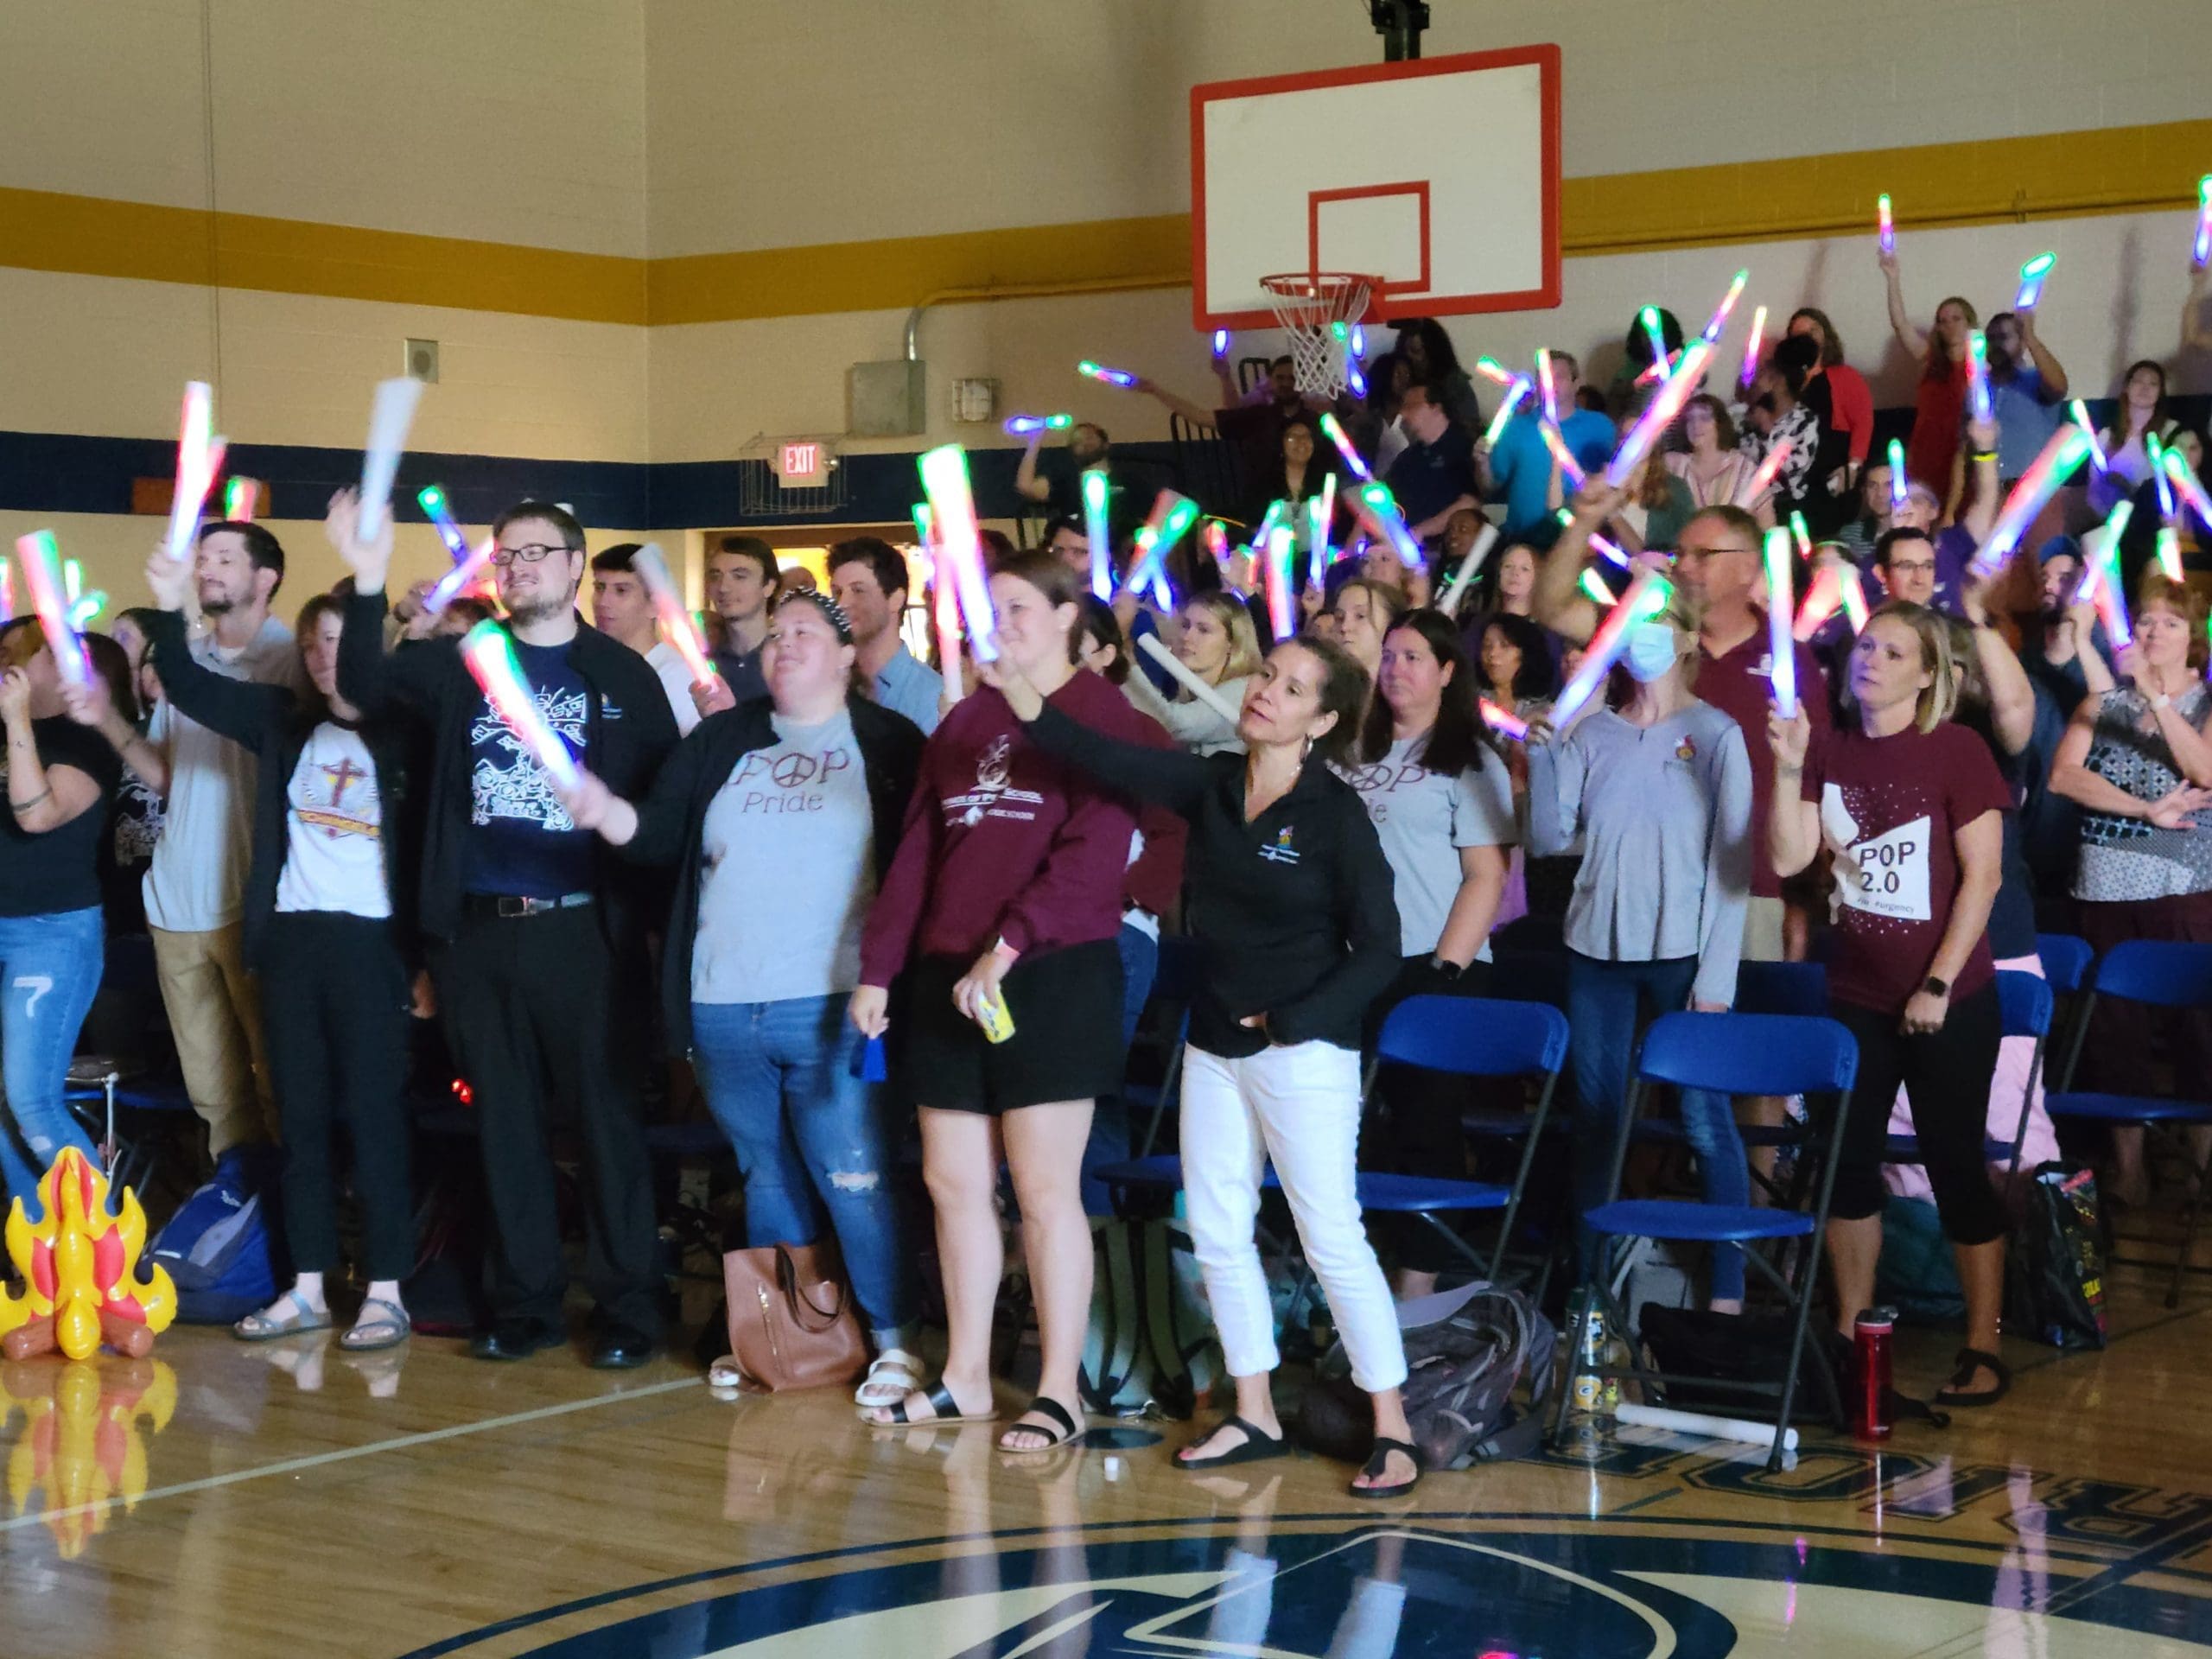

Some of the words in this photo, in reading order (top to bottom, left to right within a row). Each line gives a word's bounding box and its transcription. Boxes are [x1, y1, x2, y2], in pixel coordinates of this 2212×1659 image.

[785, 444, 816, 474] EXIT
[741, 791, 823, 813] Pride
[1859, 841, 1916, 868] POP
[1860, 871, 1900, 893] 2.0
